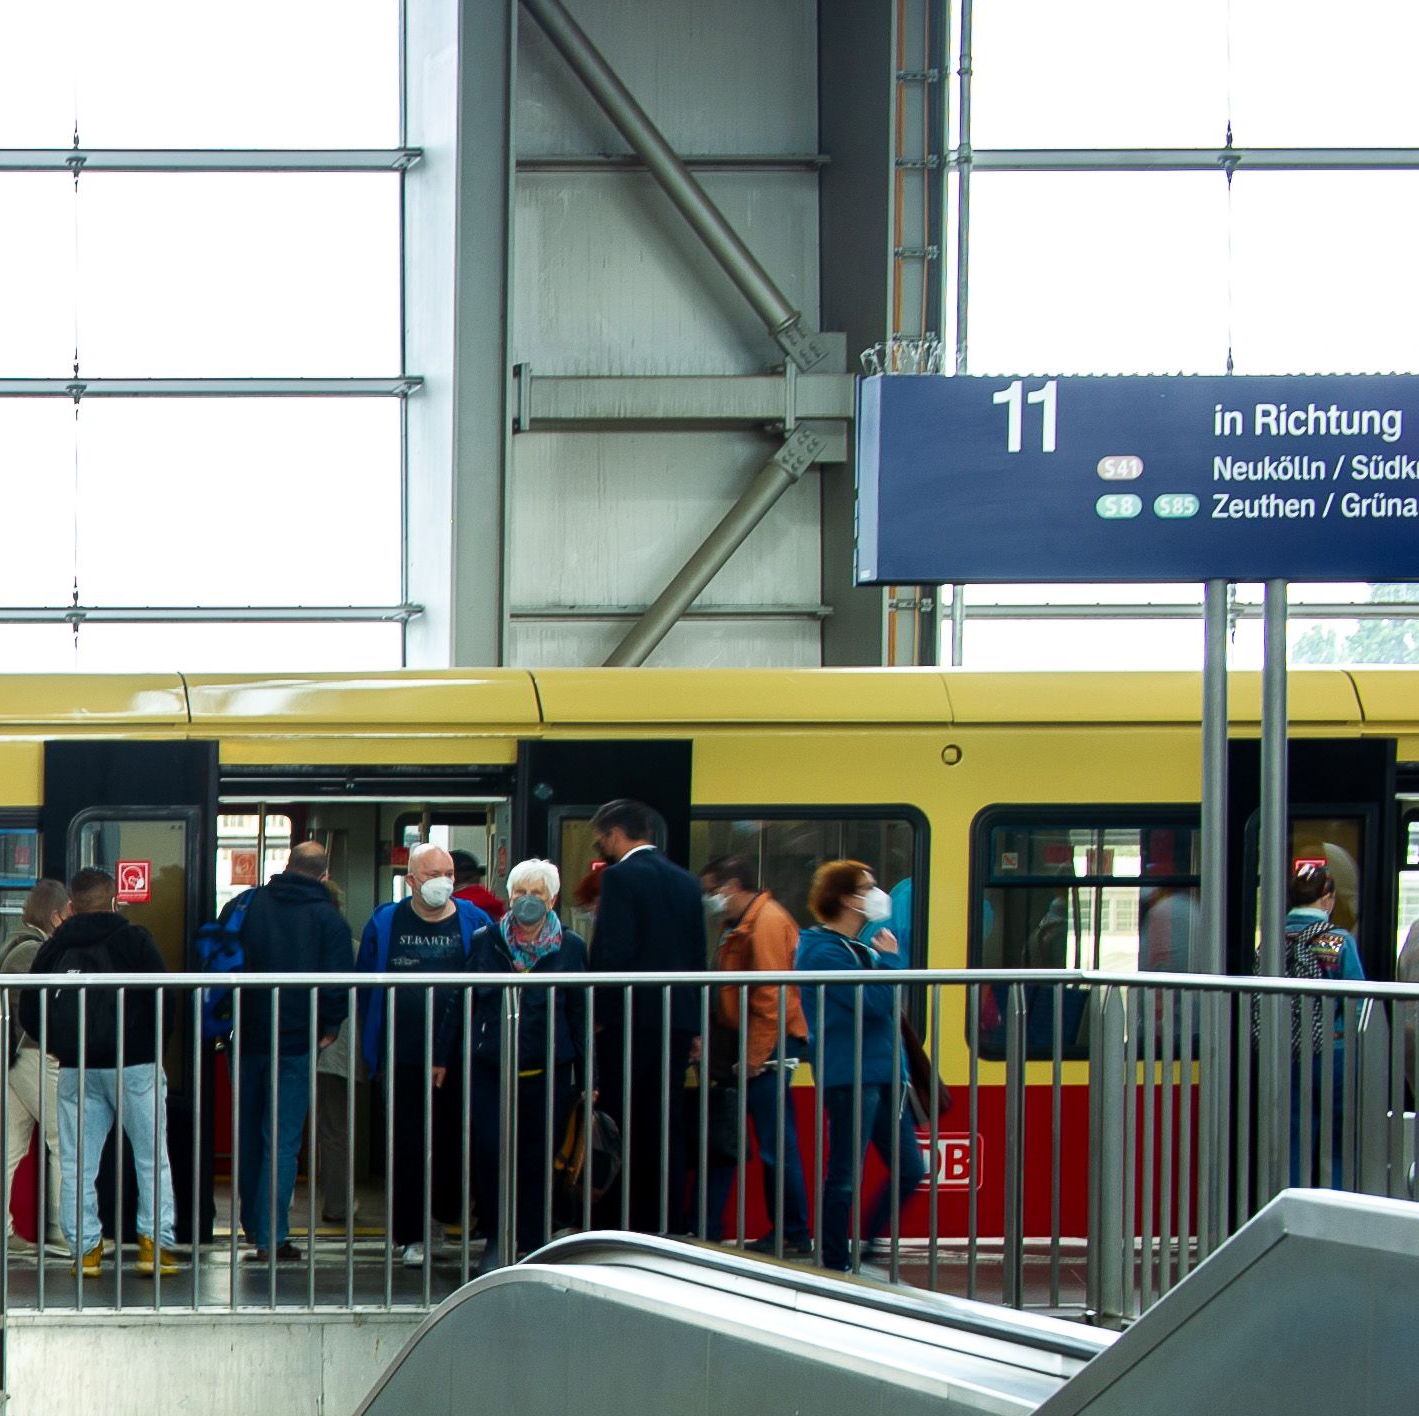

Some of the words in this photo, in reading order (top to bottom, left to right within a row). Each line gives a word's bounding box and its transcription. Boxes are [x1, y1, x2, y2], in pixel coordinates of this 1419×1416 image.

[993, 380, 1057, 453] 11
[1214, 403, 1243, 436] in
[1255, 403, 1403, 442] Richtung
[1104, 459, 1139, 477] S41
[1213, 455, 1326, 480] Neukölln
[1333, 455, 1345, 480] /
[1160, 496, 1196, 515] S85
[1212, 493, 1315, 519] Zeuthen
[1322, 493, 1335, 519] /
[1341, 493, 1419, 519] Grüna
